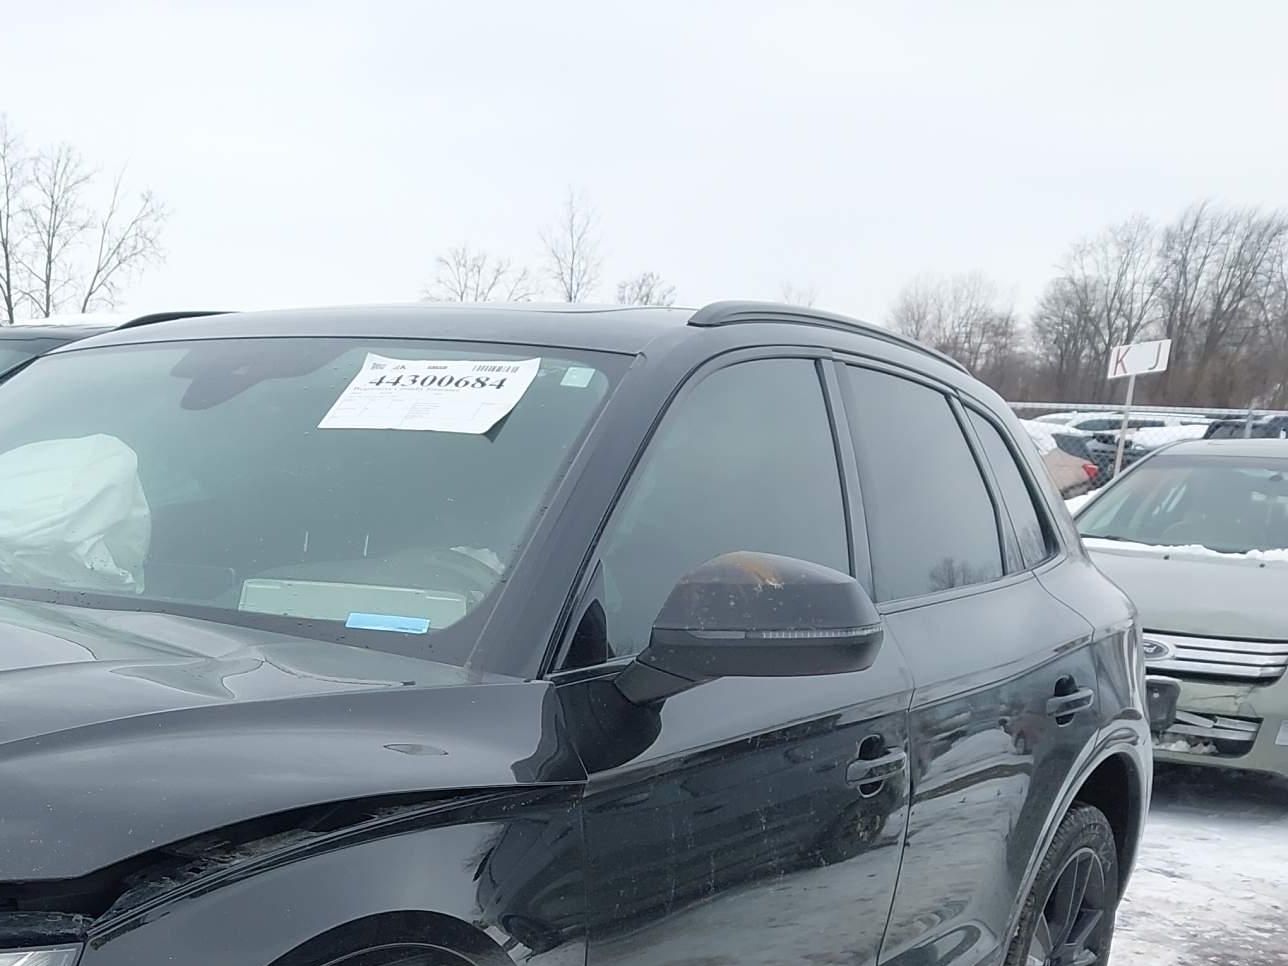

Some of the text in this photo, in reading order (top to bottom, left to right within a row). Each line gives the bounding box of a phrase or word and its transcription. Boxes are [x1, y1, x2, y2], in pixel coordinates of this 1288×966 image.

[1114, 342, 1161, 376] K J
[368, 373, 508, 391] 44300684
